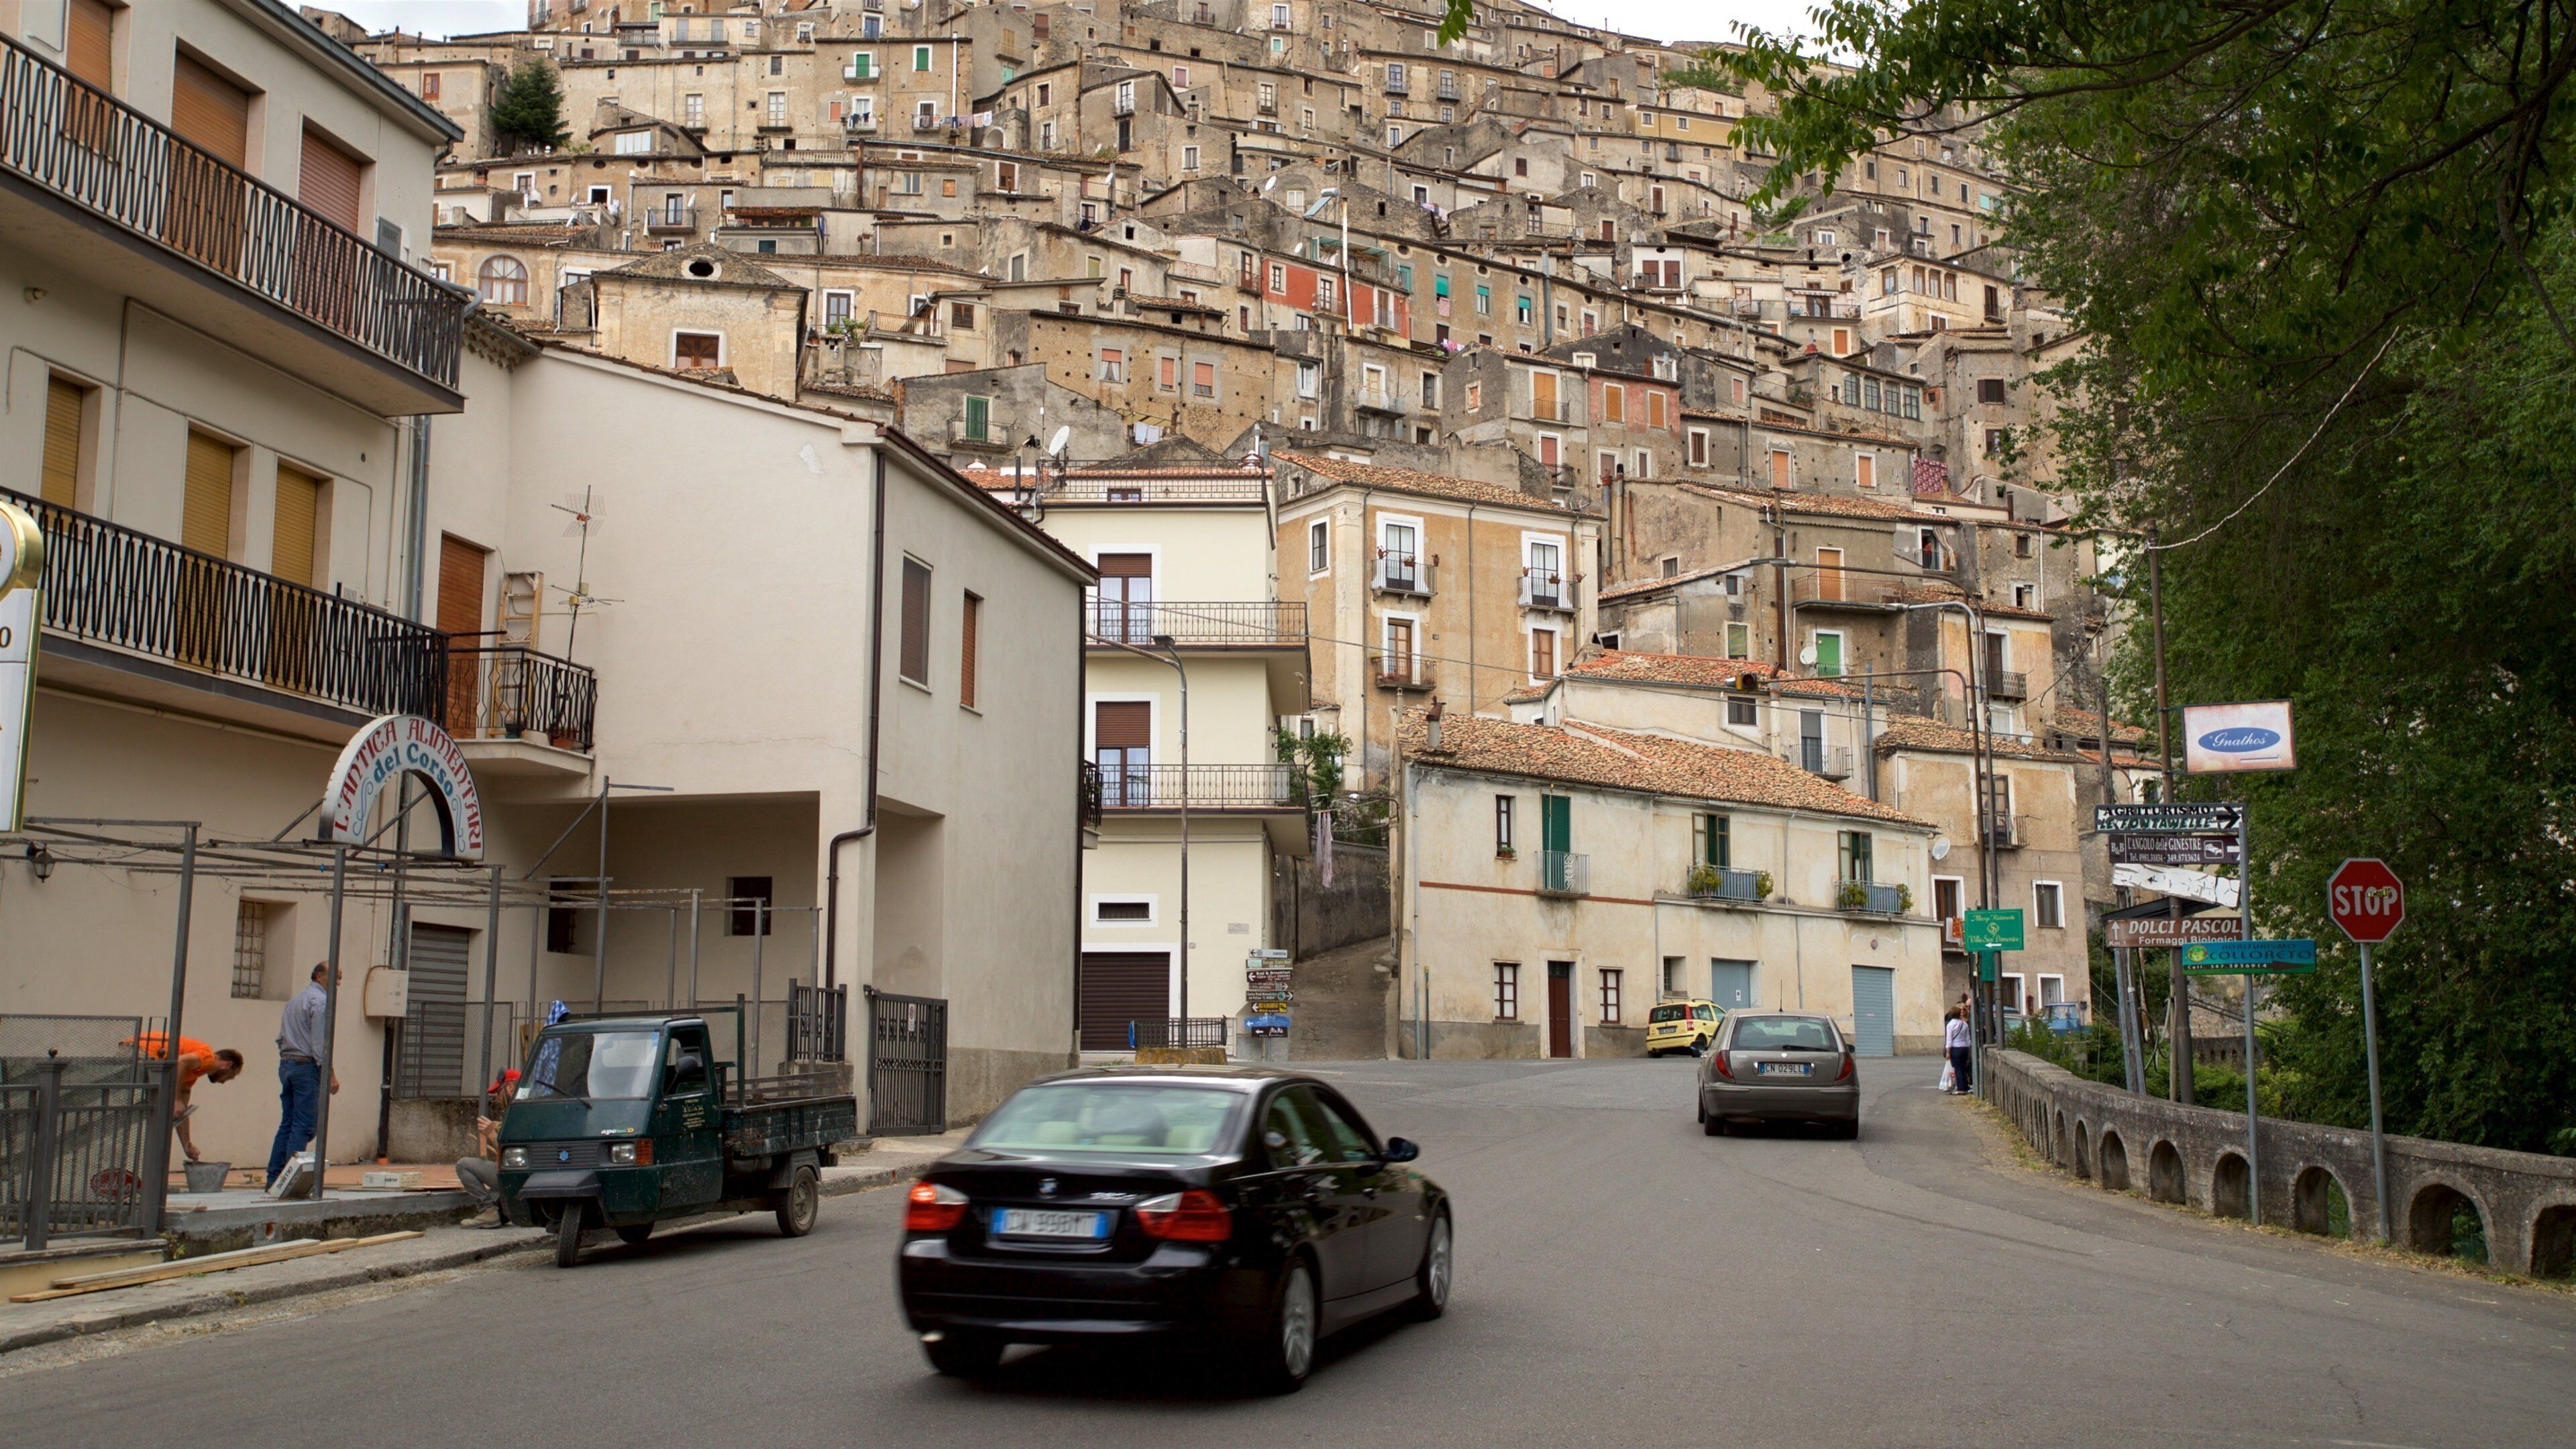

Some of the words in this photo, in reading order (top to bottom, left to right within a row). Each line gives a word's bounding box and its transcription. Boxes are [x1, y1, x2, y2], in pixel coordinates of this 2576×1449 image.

[373, 748, 402, 784] del
[406, 742, 454, 797] Corso
[335, 720, 398, 833] L'ANTICA
[407, 718, 482, 849] ALIMENTARI
[2103, 806, 2211, 816] AGRITURISMO
[2110, 842, 2125, 855] B&B
[2127, 838, 2155, 850] L'ANGOLO
[2155, 838, 2167, 851] delle
[2168, 837, 2202, 851] GINESTRE
[2130, 852, 2139, 861] Tel.
[2167, 853, 2200, 862] 349.8713624
[2334, 885, 2398, 916] STOP
[2128, 920, 2175, 934] DOLCI
[2180, 919, 2243, 934] PASCOL
[2138, 936, 2187, 946] Formaggi
[2209, 949, 2312, 960] COLLORETO
[1765, 1065, 1775, 1073] CN
[1778, 1065, 1803, 1073] 029LL
